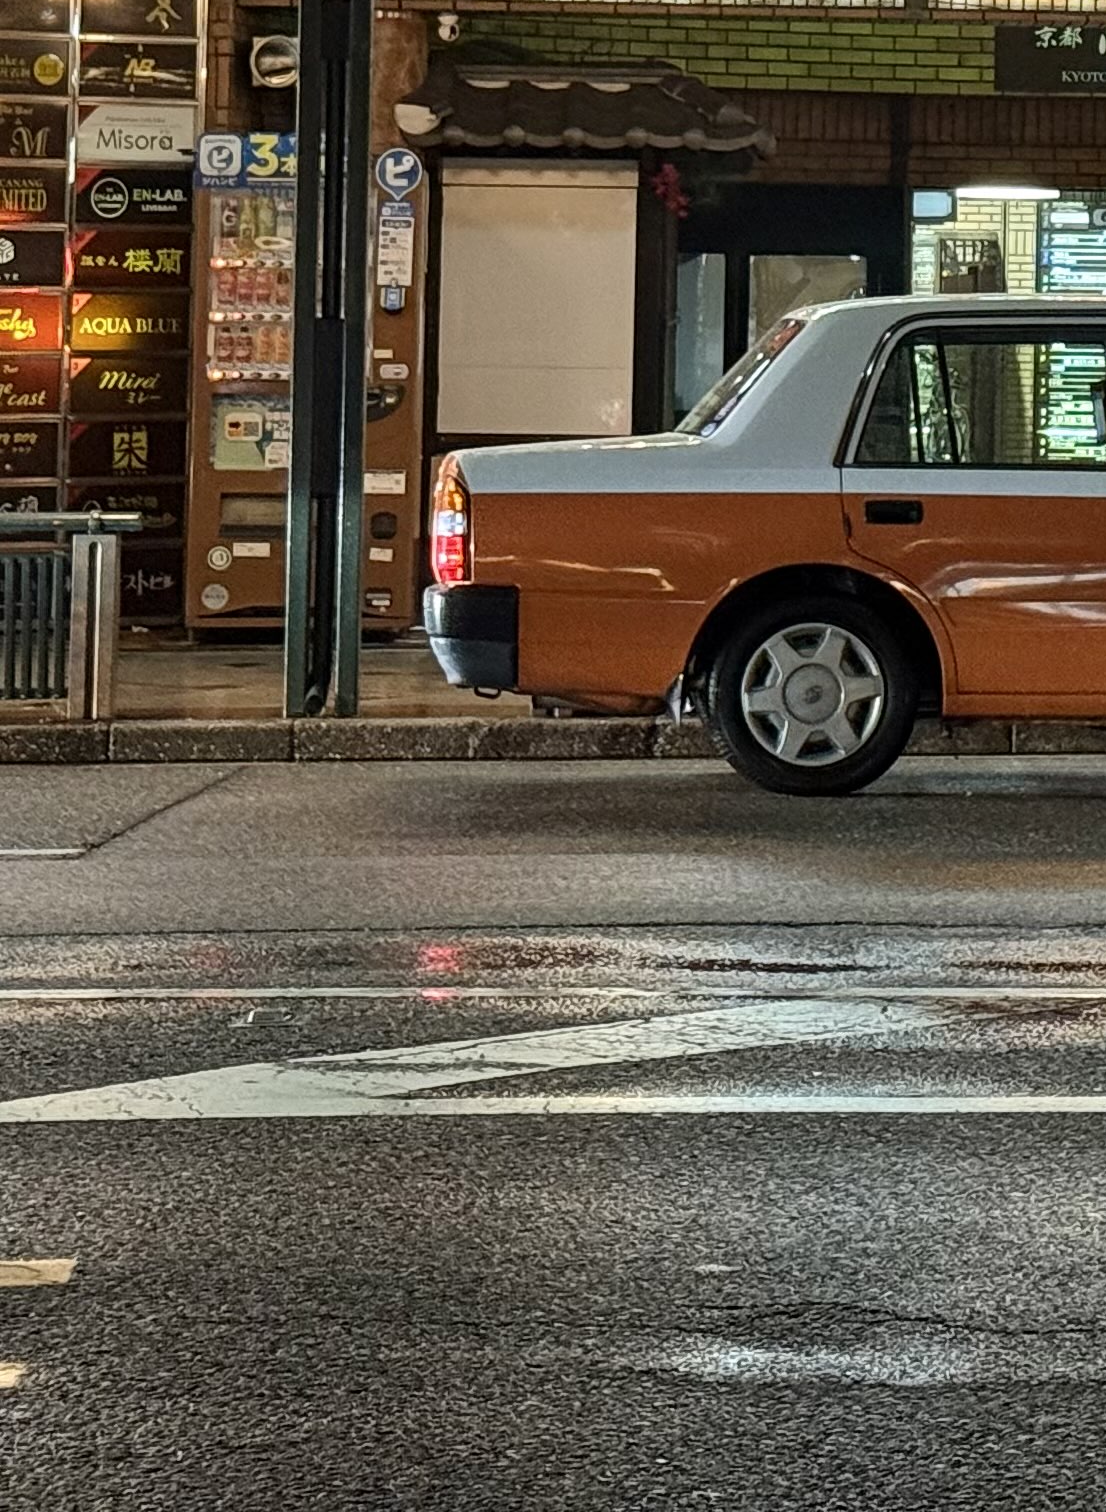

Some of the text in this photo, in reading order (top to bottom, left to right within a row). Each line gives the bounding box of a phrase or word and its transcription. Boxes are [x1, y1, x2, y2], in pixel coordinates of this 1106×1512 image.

[1034, 26, 1082, 48] 京都
[96, 127, 173, 150] Misora
[122, 249, 184, 275] 楼蘭
[79, 317, 181, 336] AQUA BLUE
[121, 569, 175, 597] ストビル
